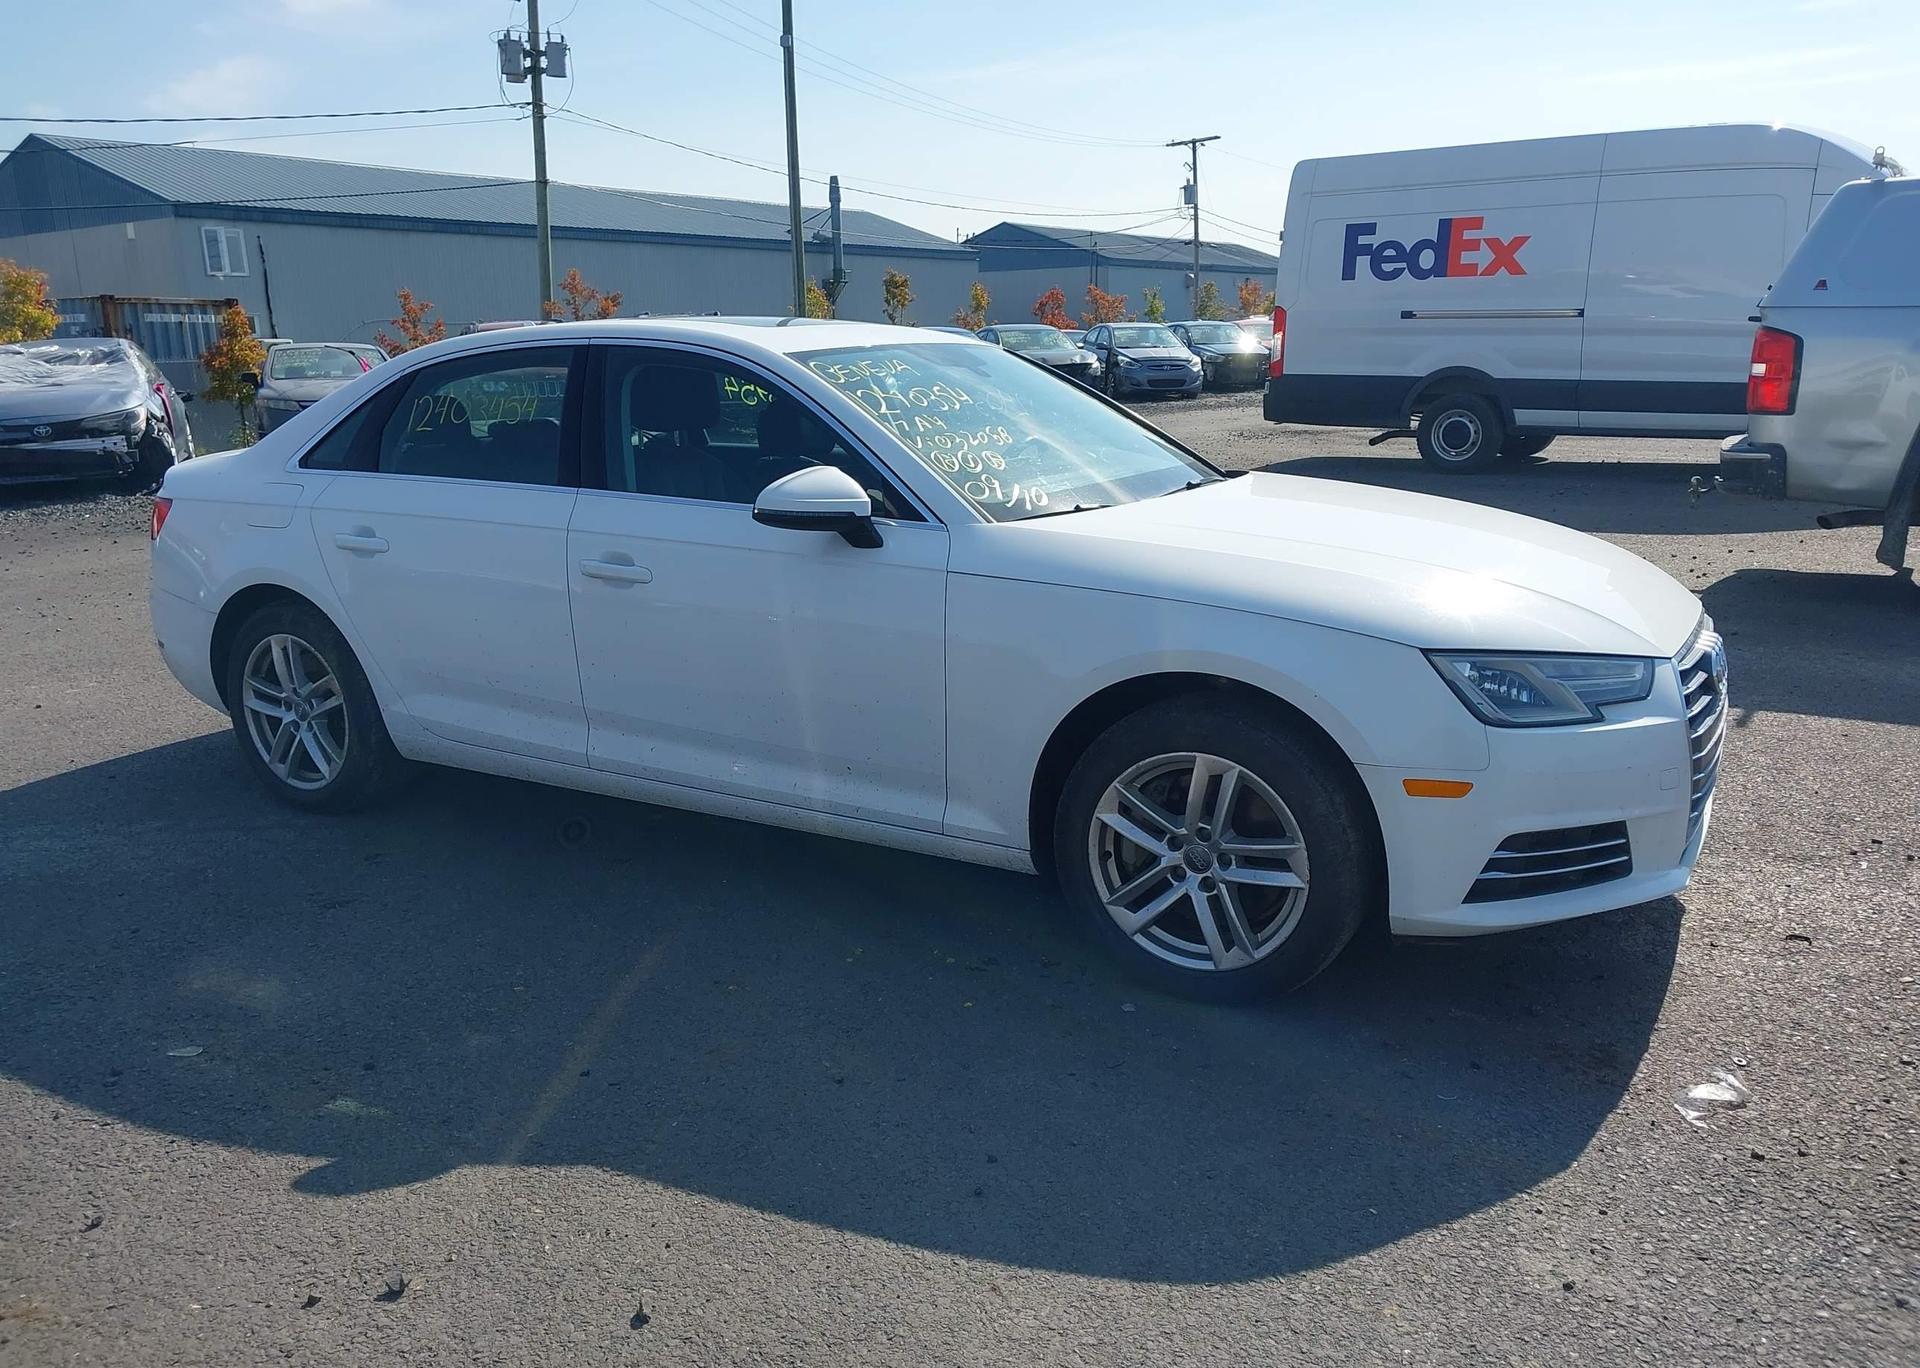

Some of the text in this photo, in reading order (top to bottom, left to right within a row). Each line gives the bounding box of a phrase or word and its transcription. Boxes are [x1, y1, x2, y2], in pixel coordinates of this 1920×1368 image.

[1341, 216, 1532, 281] FedEx
[809, 359, 920, 384] GENEVA
[408, 390, 538, 432] 12403454
[964, 473, 1049, 511] 09/10
